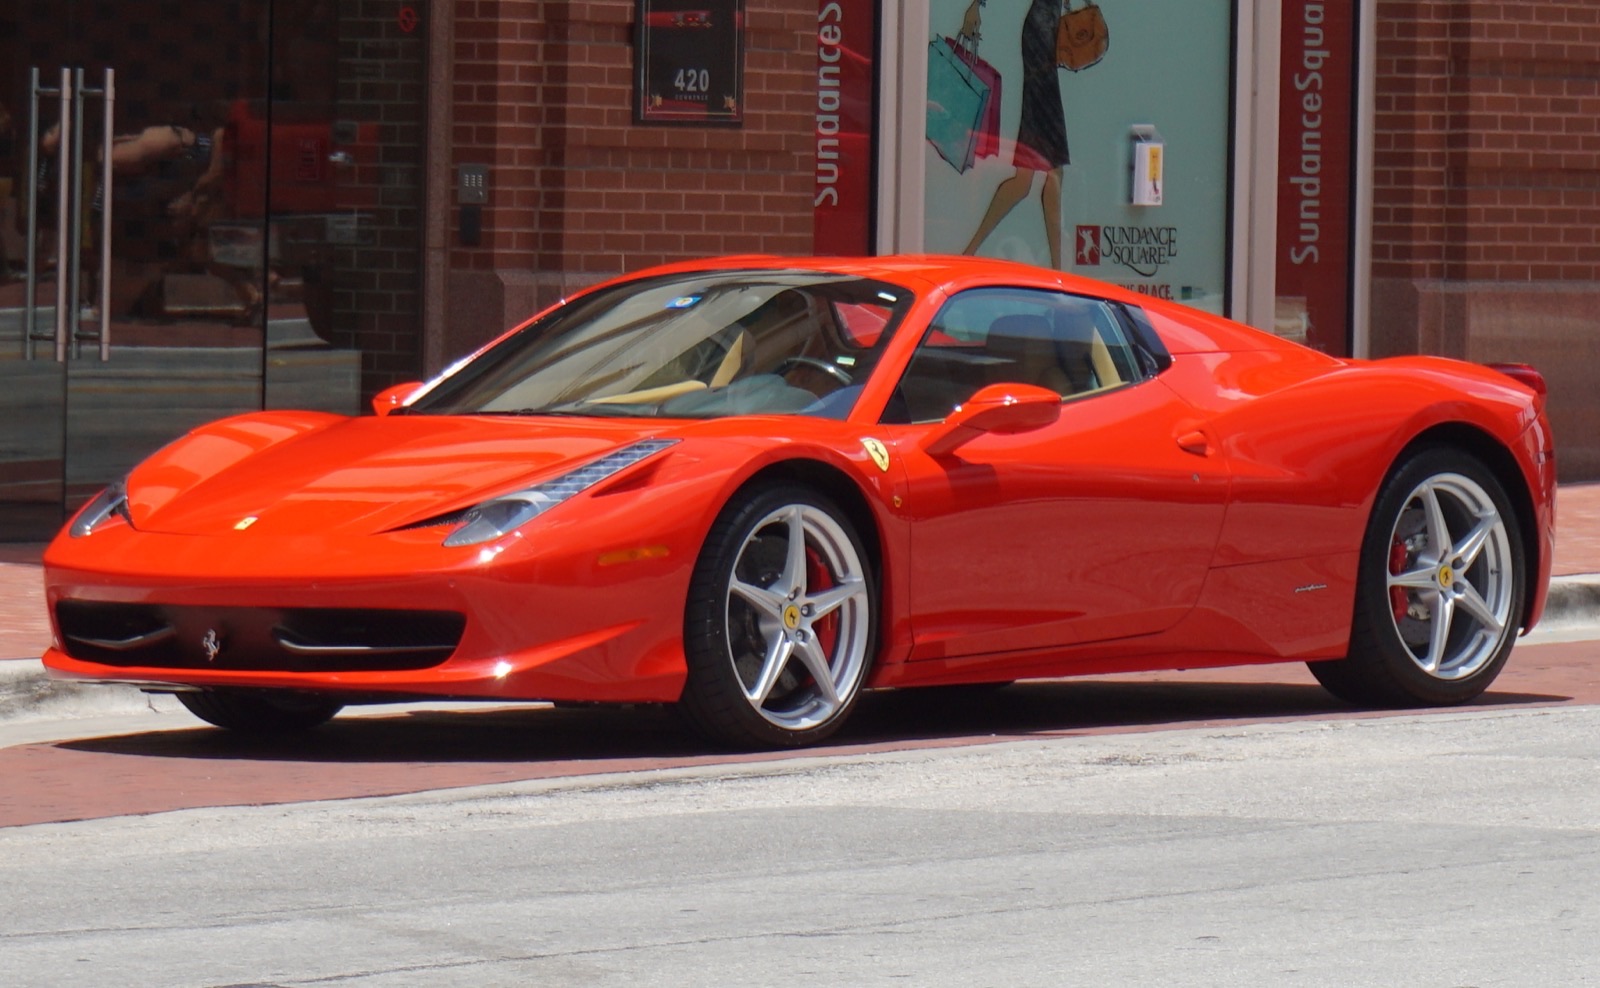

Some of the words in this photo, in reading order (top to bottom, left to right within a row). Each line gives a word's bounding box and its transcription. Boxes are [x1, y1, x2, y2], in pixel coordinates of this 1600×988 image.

[674, 68, 710, 92] 420
[1101, 226, 1178, 257] SUNDANCE
[1112, 246, 1167, 277] SQUARE
